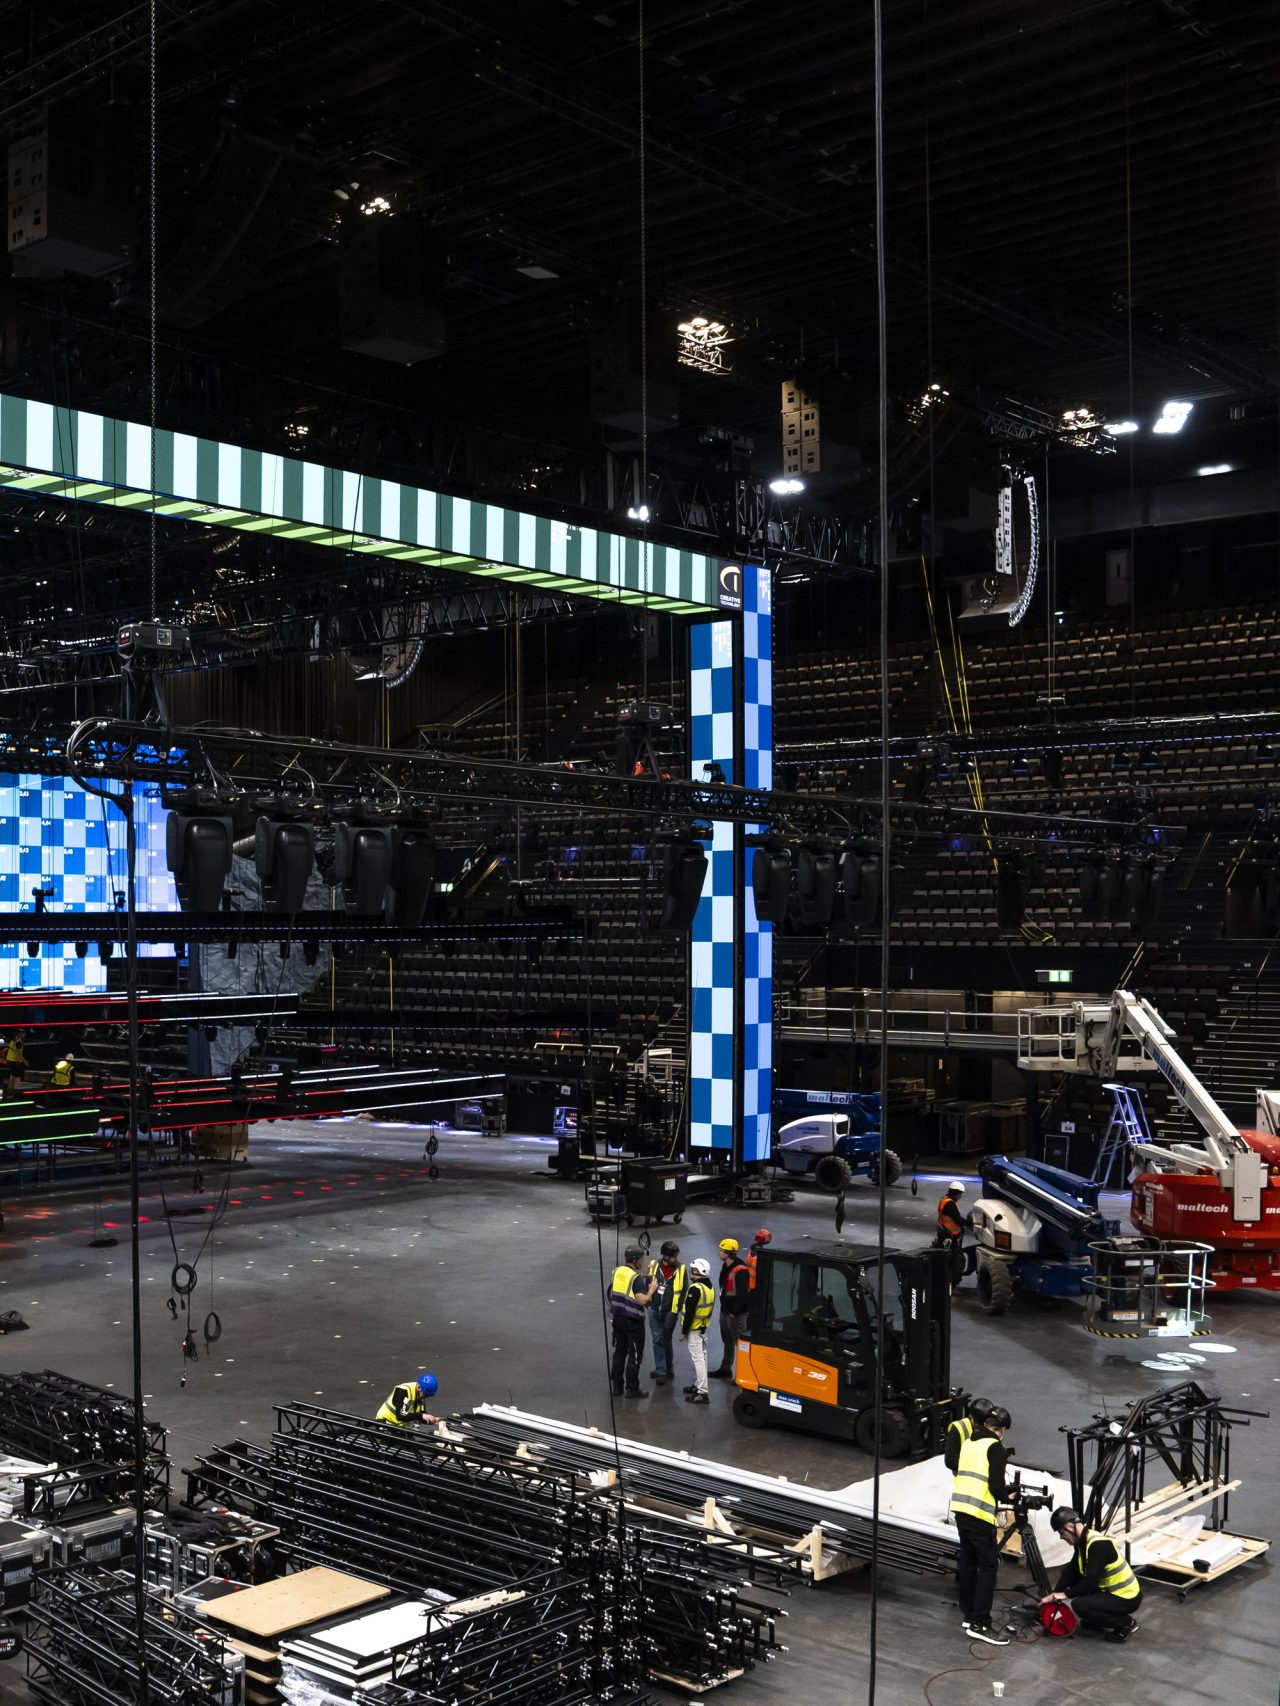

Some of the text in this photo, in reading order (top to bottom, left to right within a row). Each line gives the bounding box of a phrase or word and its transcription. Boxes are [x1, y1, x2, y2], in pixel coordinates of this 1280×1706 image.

[720, 595, 740, 603] CREATIVE
[1152, 1048, 1186, 1098] maltech
[1177, 1204, 1228, 1213] maltech
